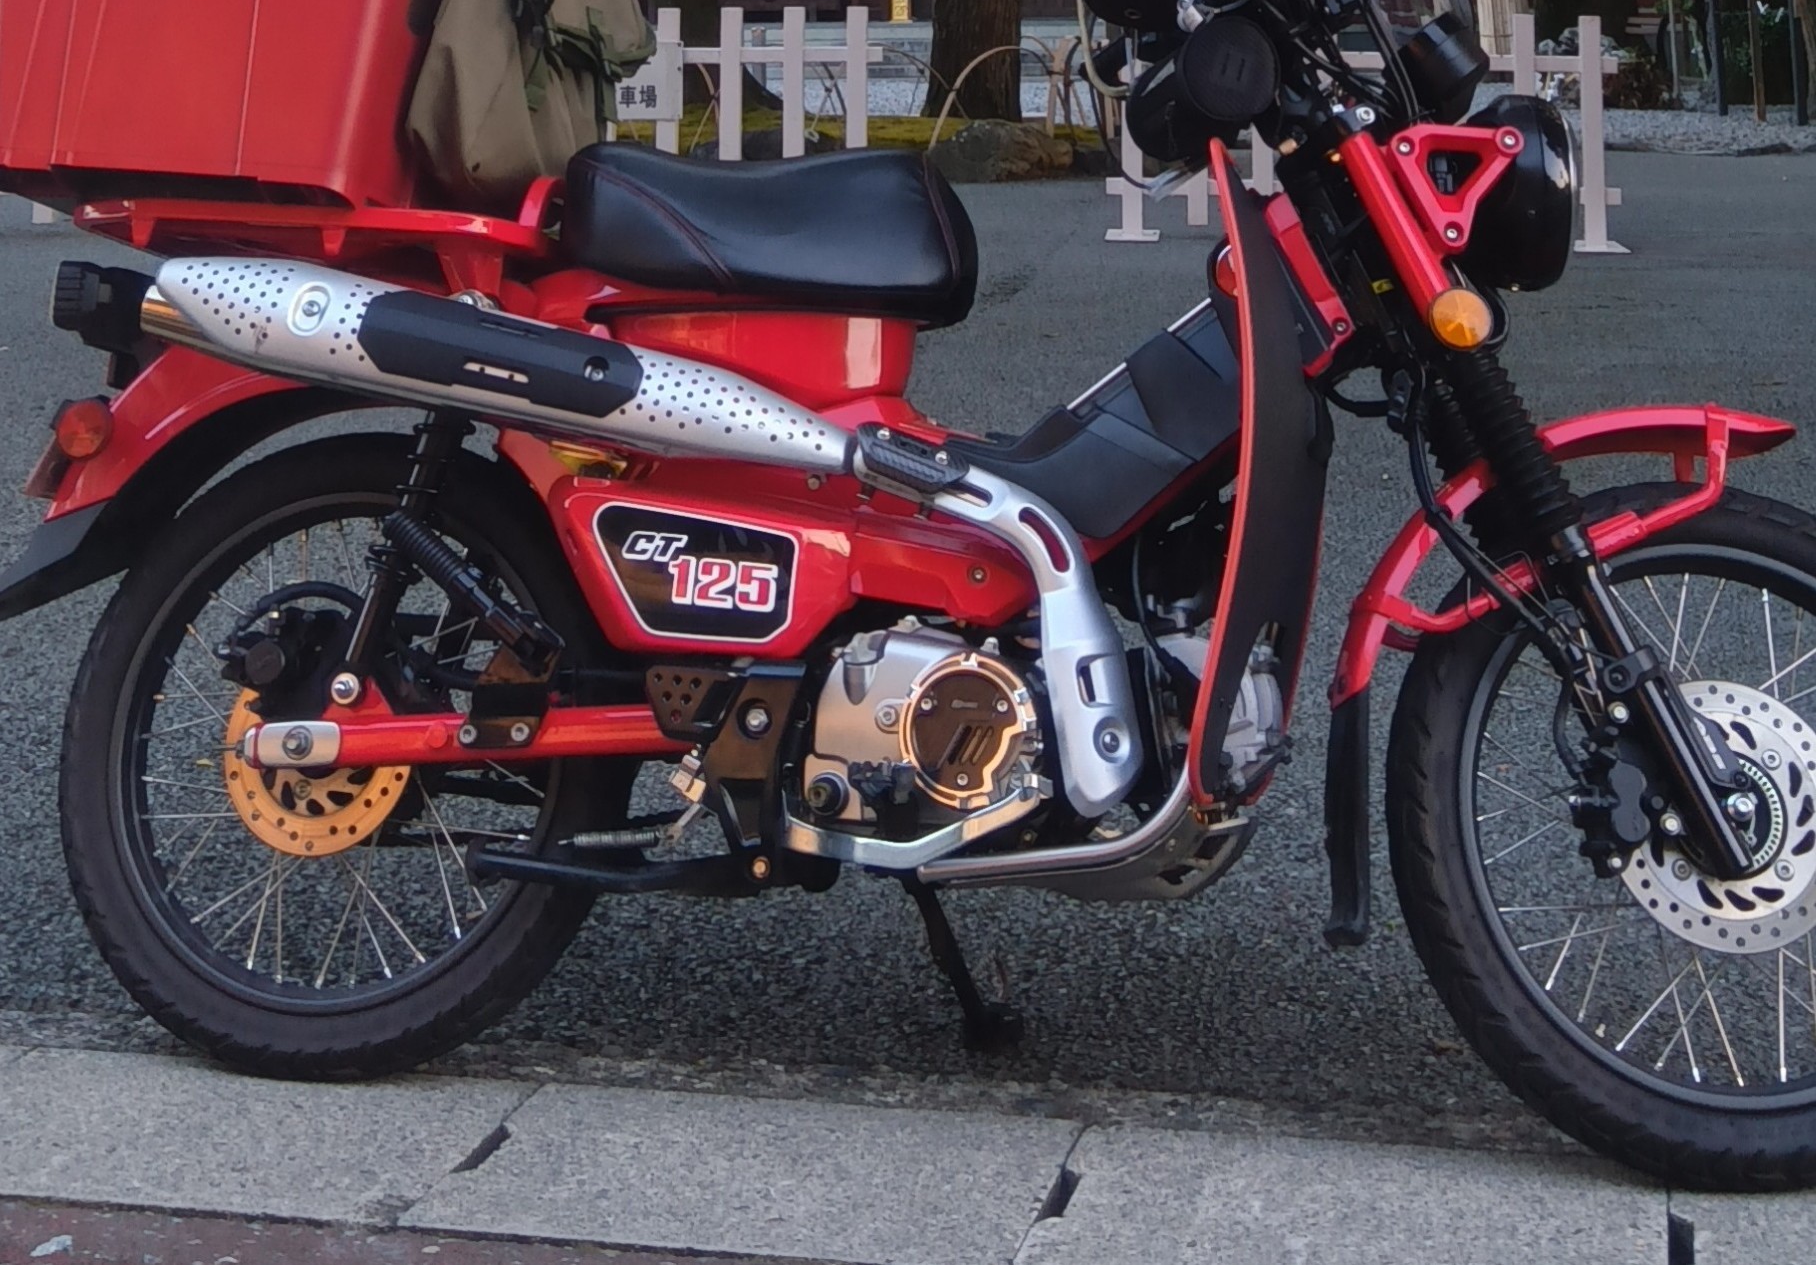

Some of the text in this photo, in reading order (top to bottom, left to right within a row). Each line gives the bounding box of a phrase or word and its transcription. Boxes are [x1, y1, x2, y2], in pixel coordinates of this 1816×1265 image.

[618, 85, 658, 109] 車場
[622, 531, 688, 562] CT
[668, 555, 778, 613] 125
